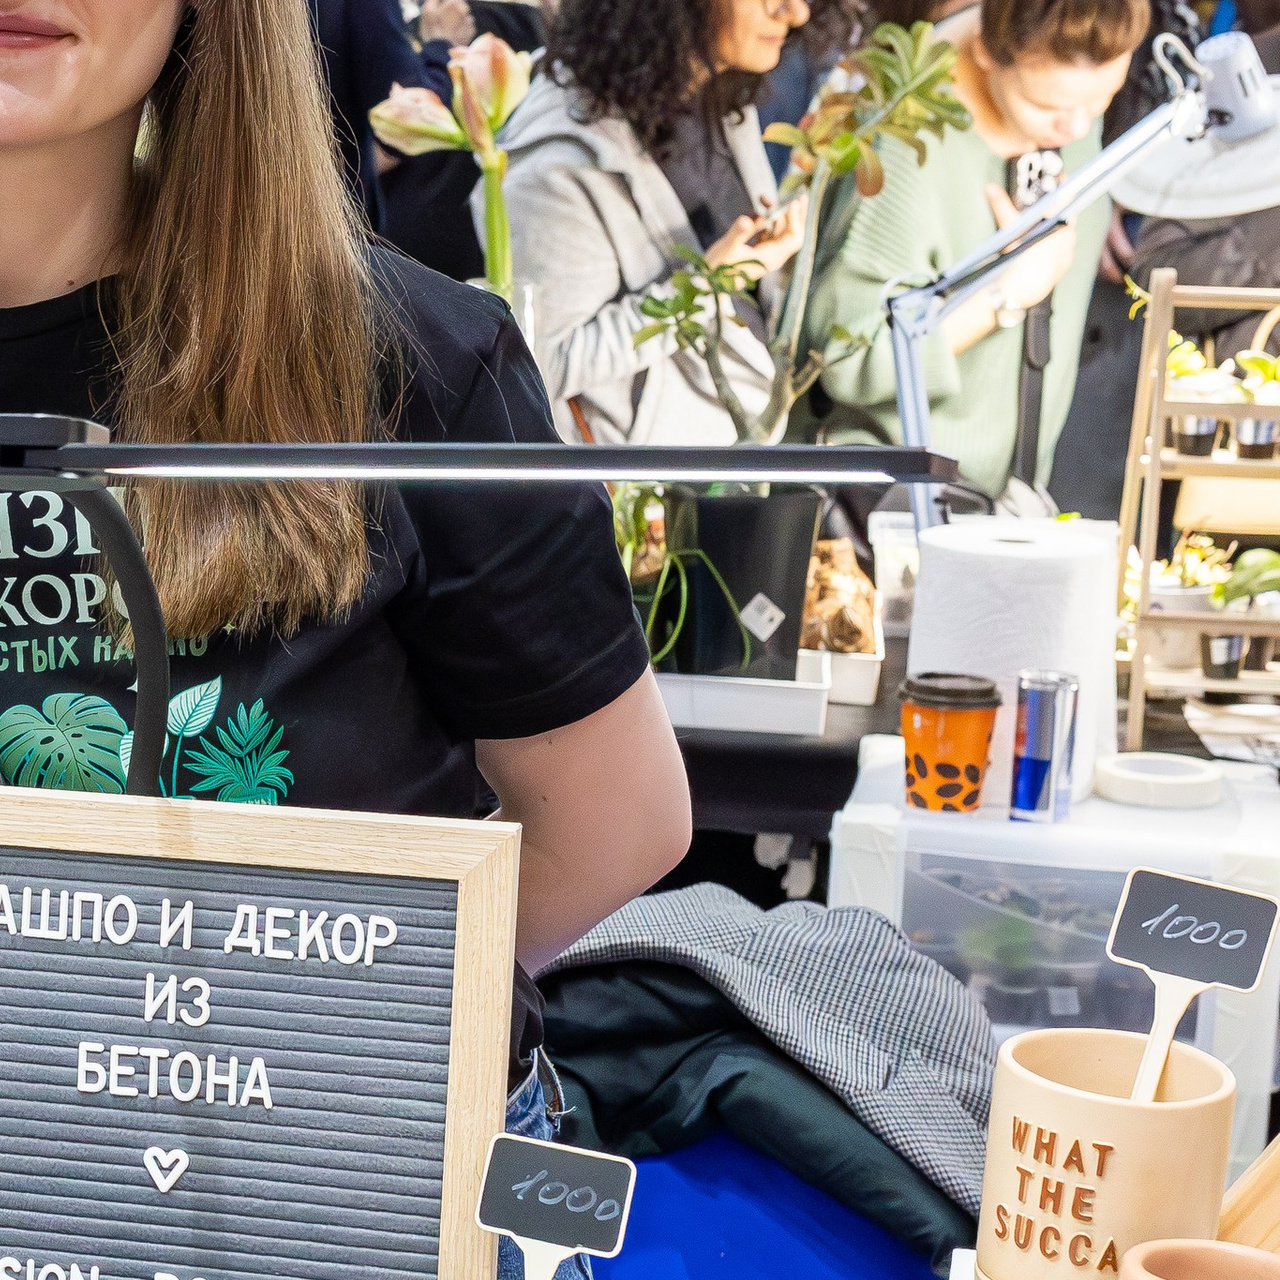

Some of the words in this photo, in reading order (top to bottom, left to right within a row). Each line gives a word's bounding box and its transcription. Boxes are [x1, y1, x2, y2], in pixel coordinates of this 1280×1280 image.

[159, 897, 194, 951] И
[224, 903, 399, 967] ДЕКОР
[1141, 903, 1248, 950] 1000
[143, 972, 211, 1027] ИЗ
[76, 1040, 274, 1110] БЕТОНА
[1011, 1114, 1115, 1178] WHAT
[511, 1169, 621, 1222] 1000
[1016, 1165, 1097, 1222] THE
[994, 1203, 1120, 1273] SUCCA
